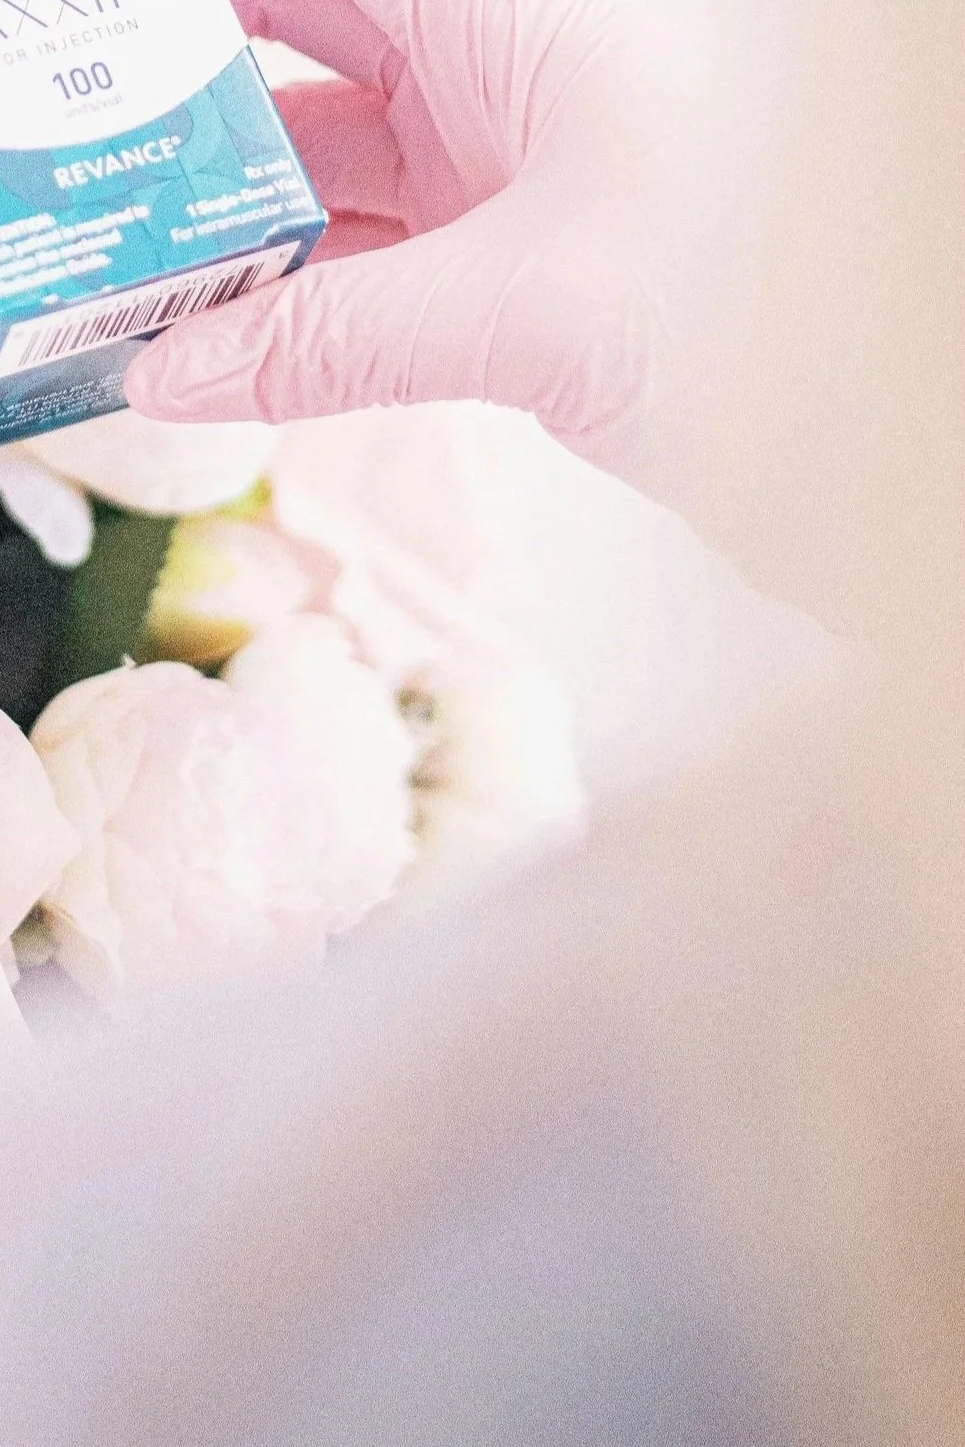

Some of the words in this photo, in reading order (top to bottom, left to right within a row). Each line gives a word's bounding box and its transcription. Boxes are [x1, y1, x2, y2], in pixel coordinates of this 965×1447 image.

[36, 17, 140, 57] INJECTION
[51, 61, 114, 101] 100
[264, 157, 293, 178] only
[170, 226, 195, 244] For
